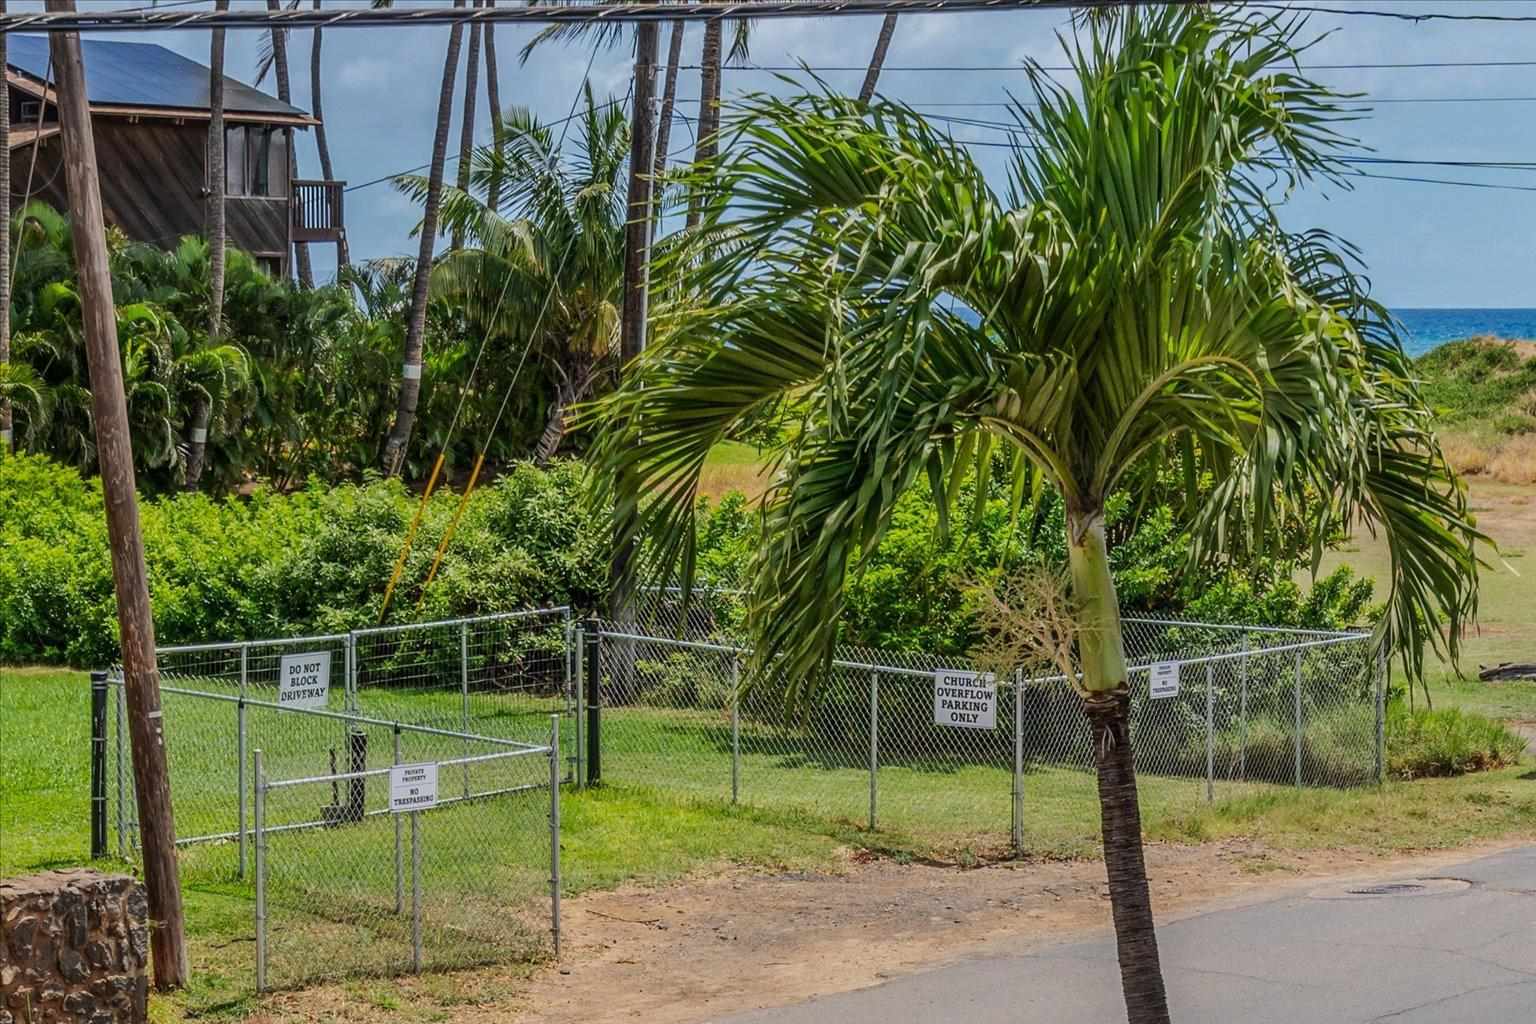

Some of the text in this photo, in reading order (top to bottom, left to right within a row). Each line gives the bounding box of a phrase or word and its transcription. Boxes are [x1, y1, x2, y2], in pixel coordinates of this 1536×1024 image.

[289, 663, 320, 675] DO NOT
[290, 675, 318, 687] BLOCK
[943, 676, 986, 688] CHURCH
[281, 687, 325, 701] DRIVEWAY
[937, 688, 993, 701] OVERFLOW
[941, 700, 988, 712] PARKING
[950, 712, 978, 723] ONLY
[394, 795, 434, 806] TRESPASSING
